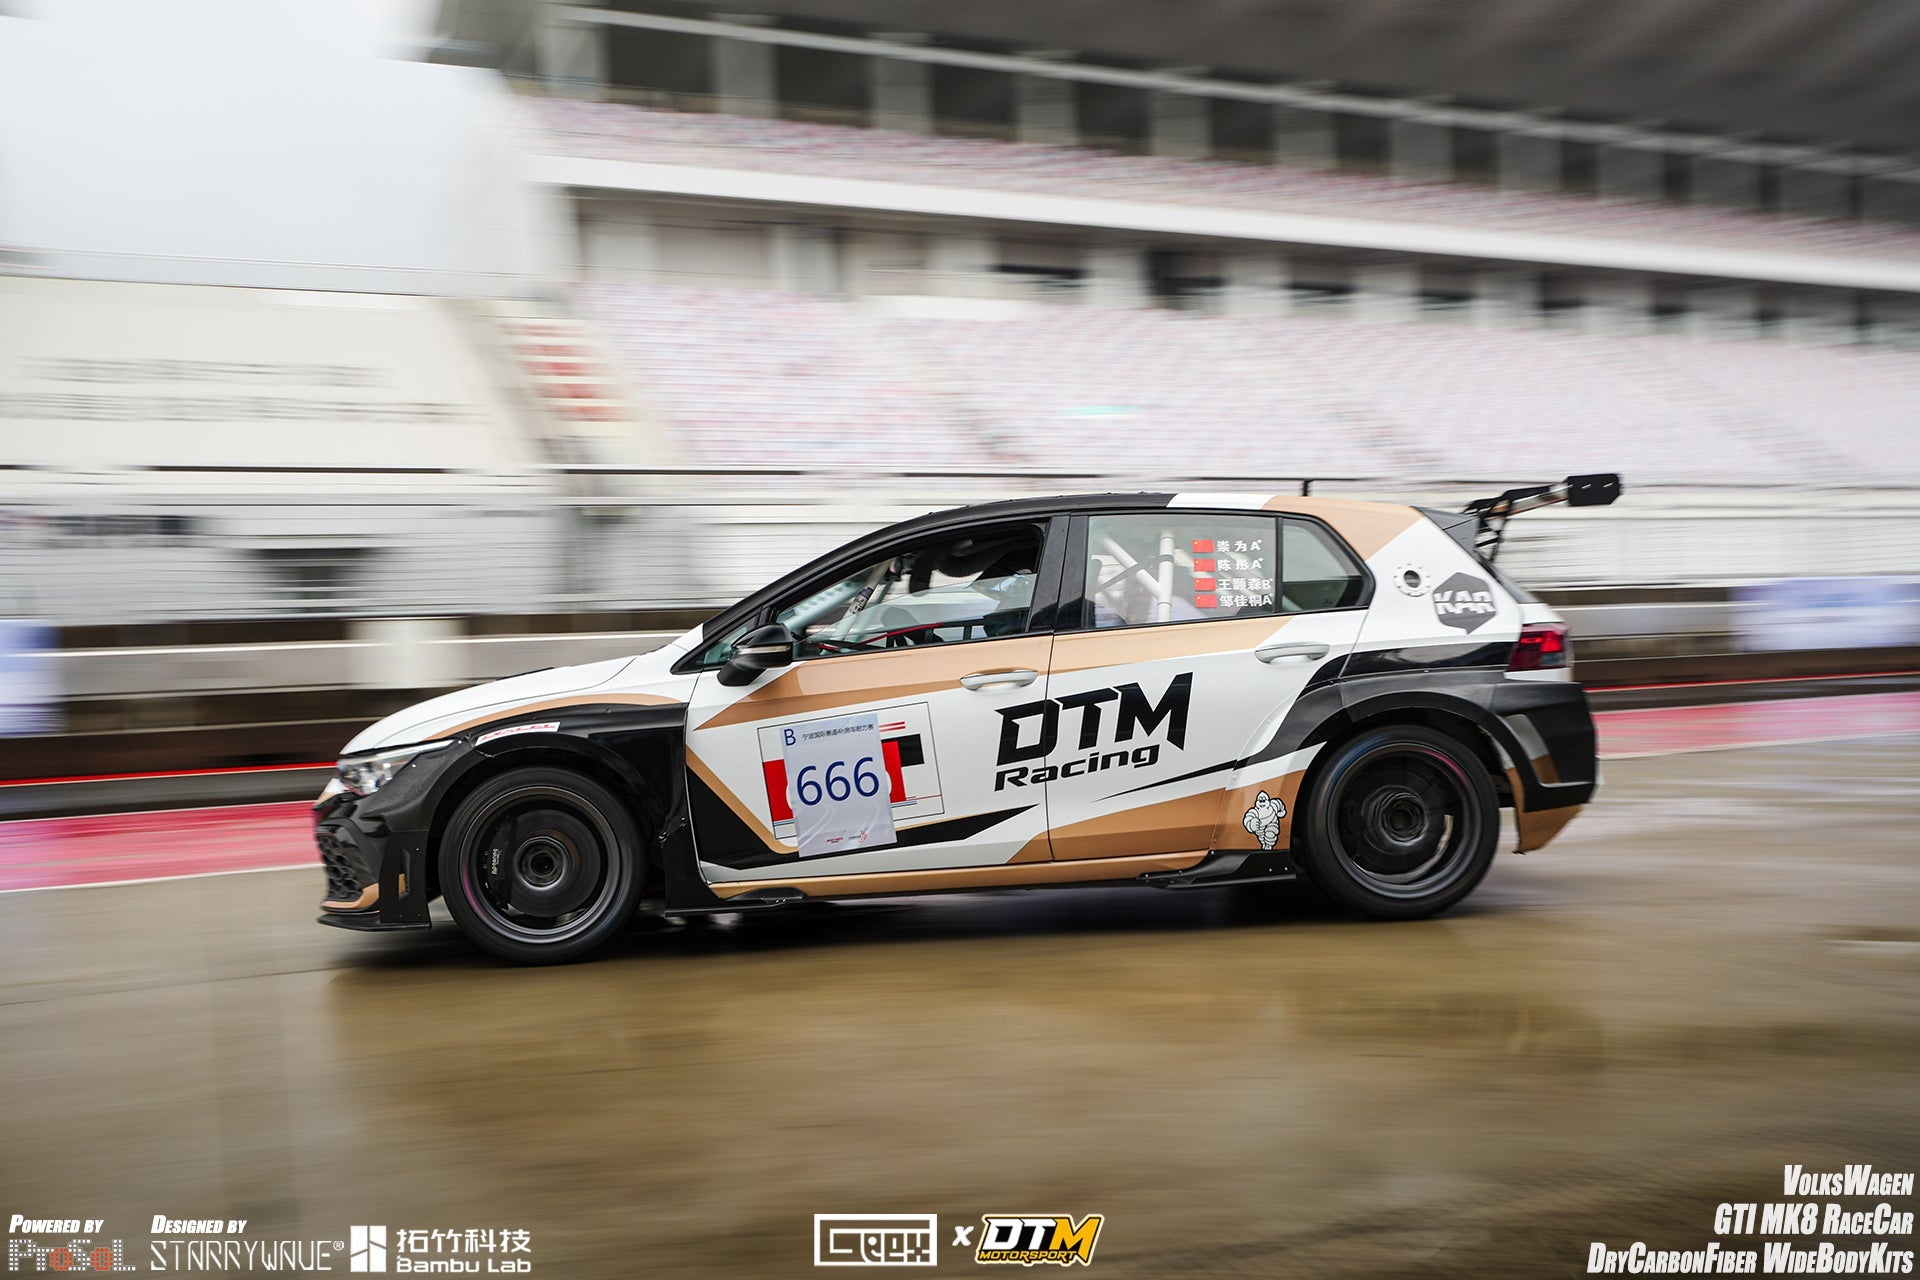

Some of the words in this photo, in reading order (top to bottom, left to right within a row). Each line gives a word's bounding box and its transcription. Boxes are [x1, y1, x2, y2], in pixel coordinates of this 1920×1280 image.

[1433, 590, 1496, 615] KAR
[784, 728, 797, 746] B
[994, 672, 1194, 767] DTM
[797, 757, 880, 806] 666
[994, 744, 1160, 792] Racing
